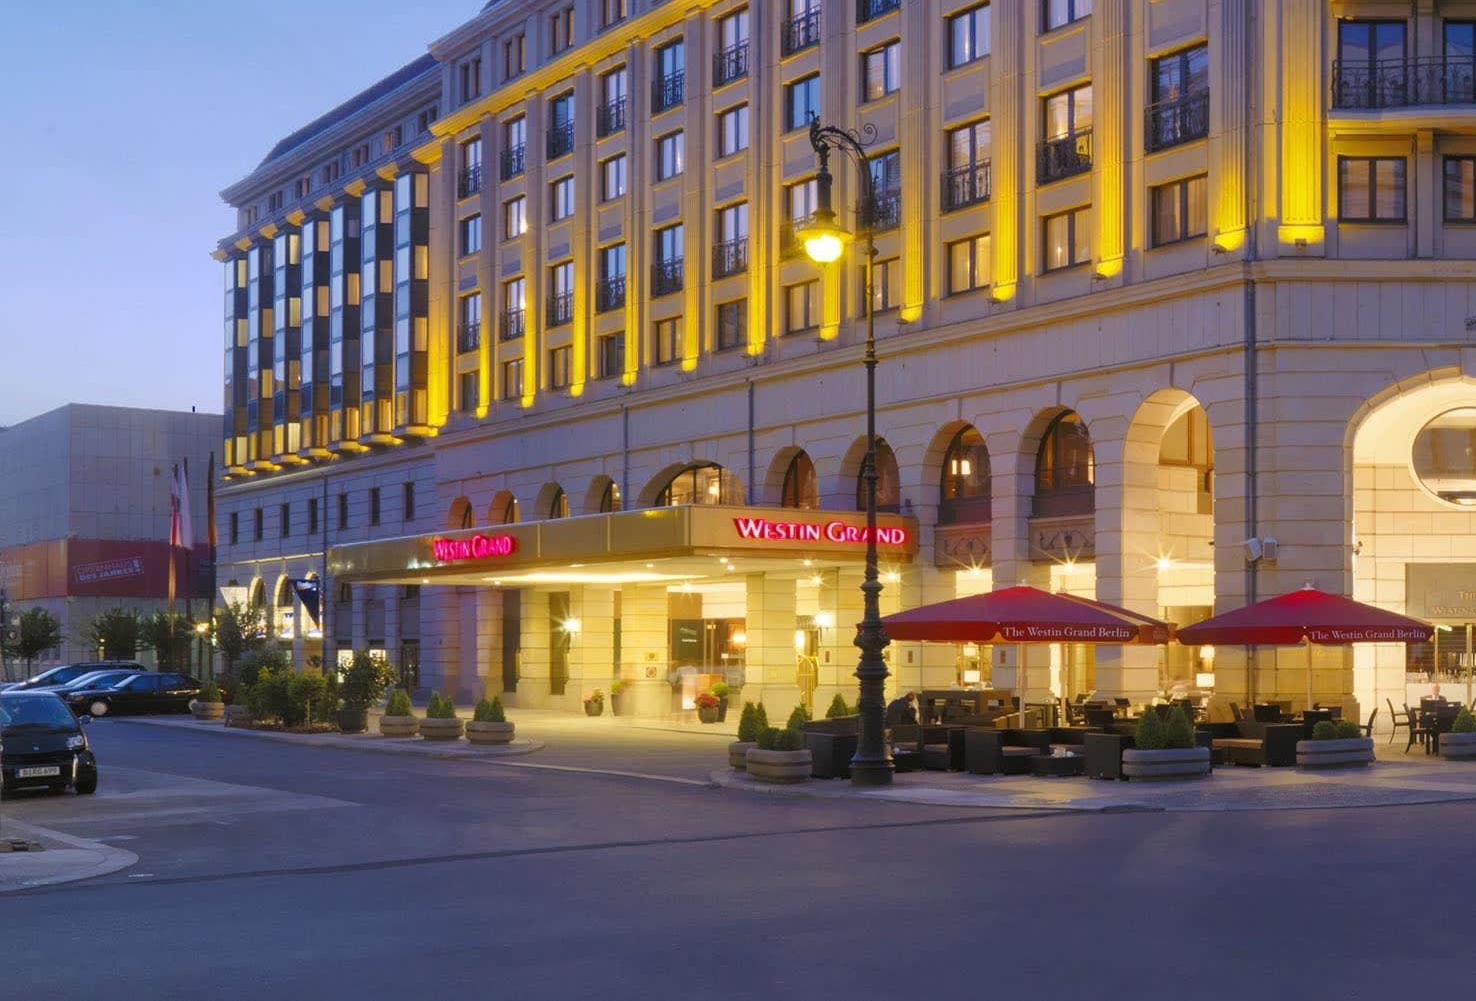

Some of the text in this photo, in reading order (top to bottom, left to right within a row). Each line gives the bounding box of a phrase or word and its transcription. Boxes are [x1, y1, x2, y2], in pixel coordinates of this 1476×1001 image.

[734, 518, 820, 540] WESTIN
[432, 539, 471, 560] WESTIN
[1003, 626, 1130, 638] The Westin Grand Berlin
[1310, 628, 1426, 640] The Westin Grand Berlin
